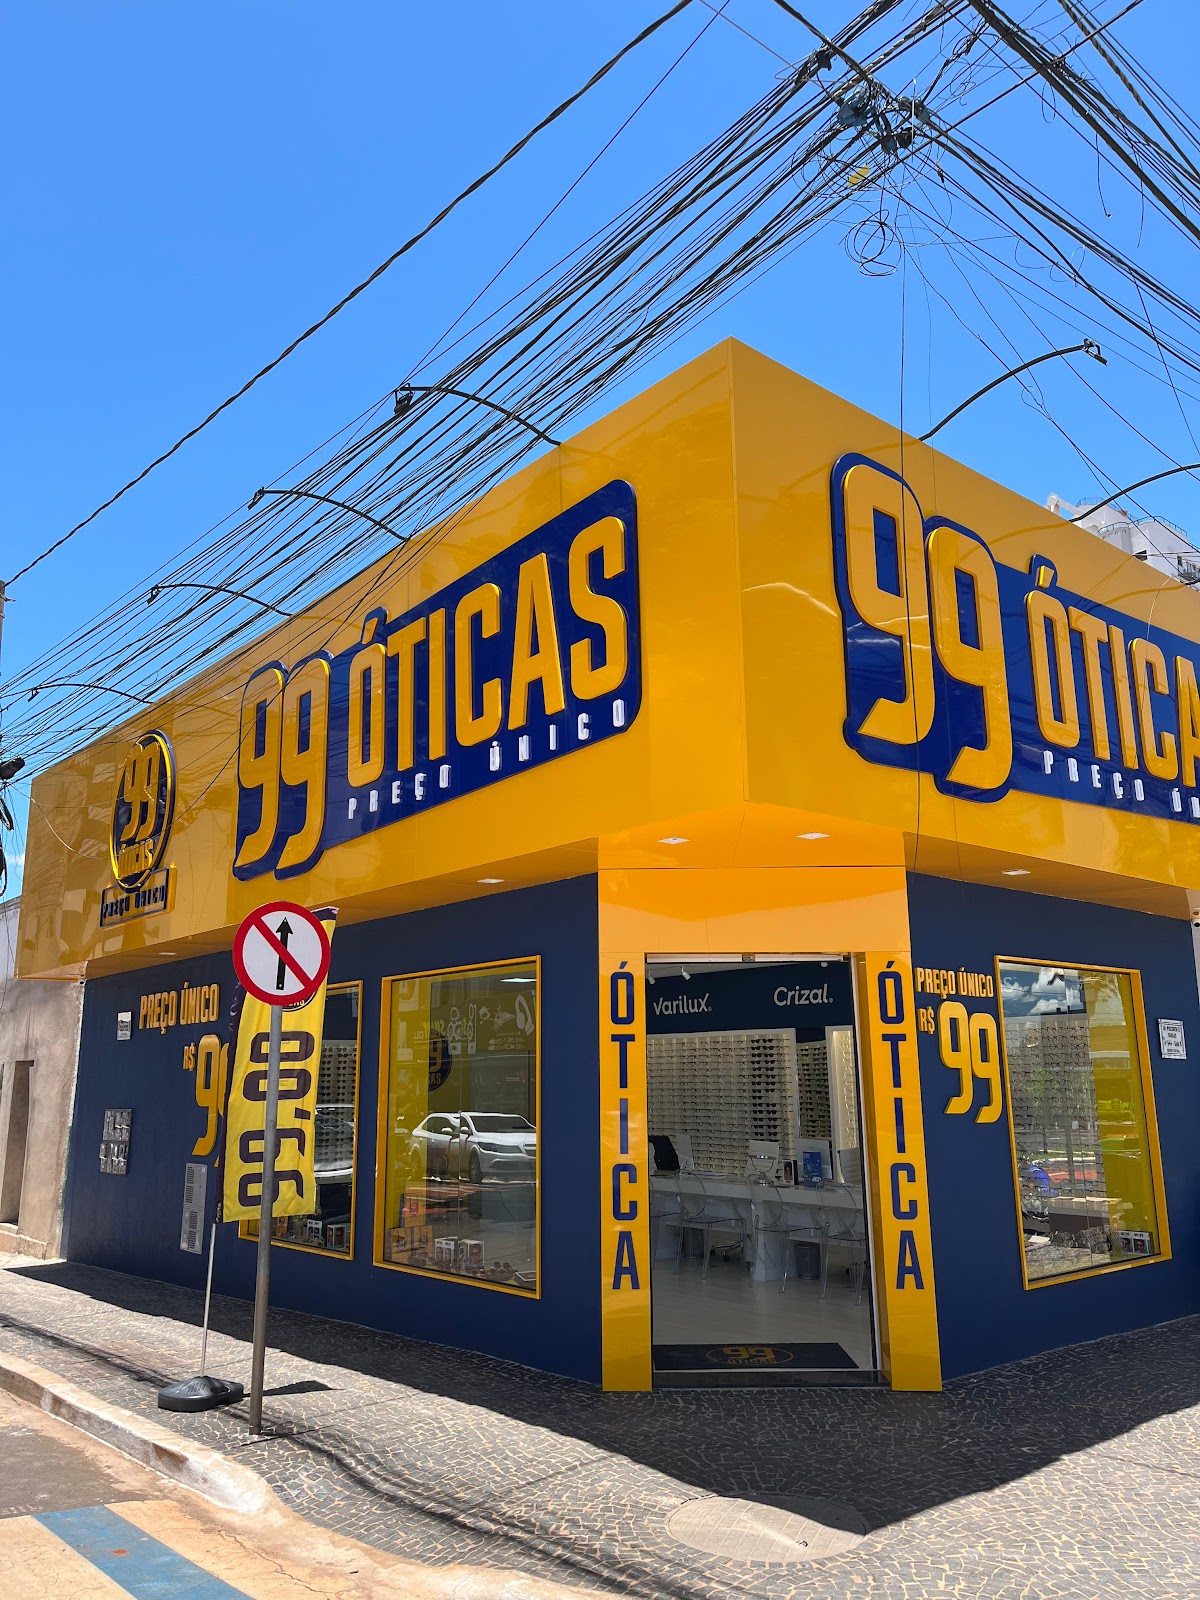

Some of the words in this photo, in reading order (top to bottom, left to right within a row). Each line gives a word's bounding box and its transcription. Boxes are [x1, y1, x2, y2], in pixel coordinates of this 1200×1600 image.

[841, 463, 1013, 790] 99
[1025, 565, 1200, 788] ÓTICA
[234, 657, 332, 870] 99
[347, 516, 629, 787] ÓTICAS
[120, 741, 161, 842] 99
[347, 764, 451, 819] PREÇO
[489, 699, 627, 772] ÚNICO
[1042, 750, 1145, 800] PREÇO
[139, 990, 178, 1034] PREÇO
[179, 981, 220, 1025] ÚNICO
[914, 967, 956, 999] PREÇO
[957, 967, 994, 998] ÚNICO
[183, 1042, 196, 1071] R$
[918, 1006, 935, 1034] R$
[938, 1001, 1003, 1124] 99
[238, 1030, 316, 1207] 99,00
[610, 961, 640, 1290] ÓTICA
[877, 960, 925, 1290] ÓTICA
